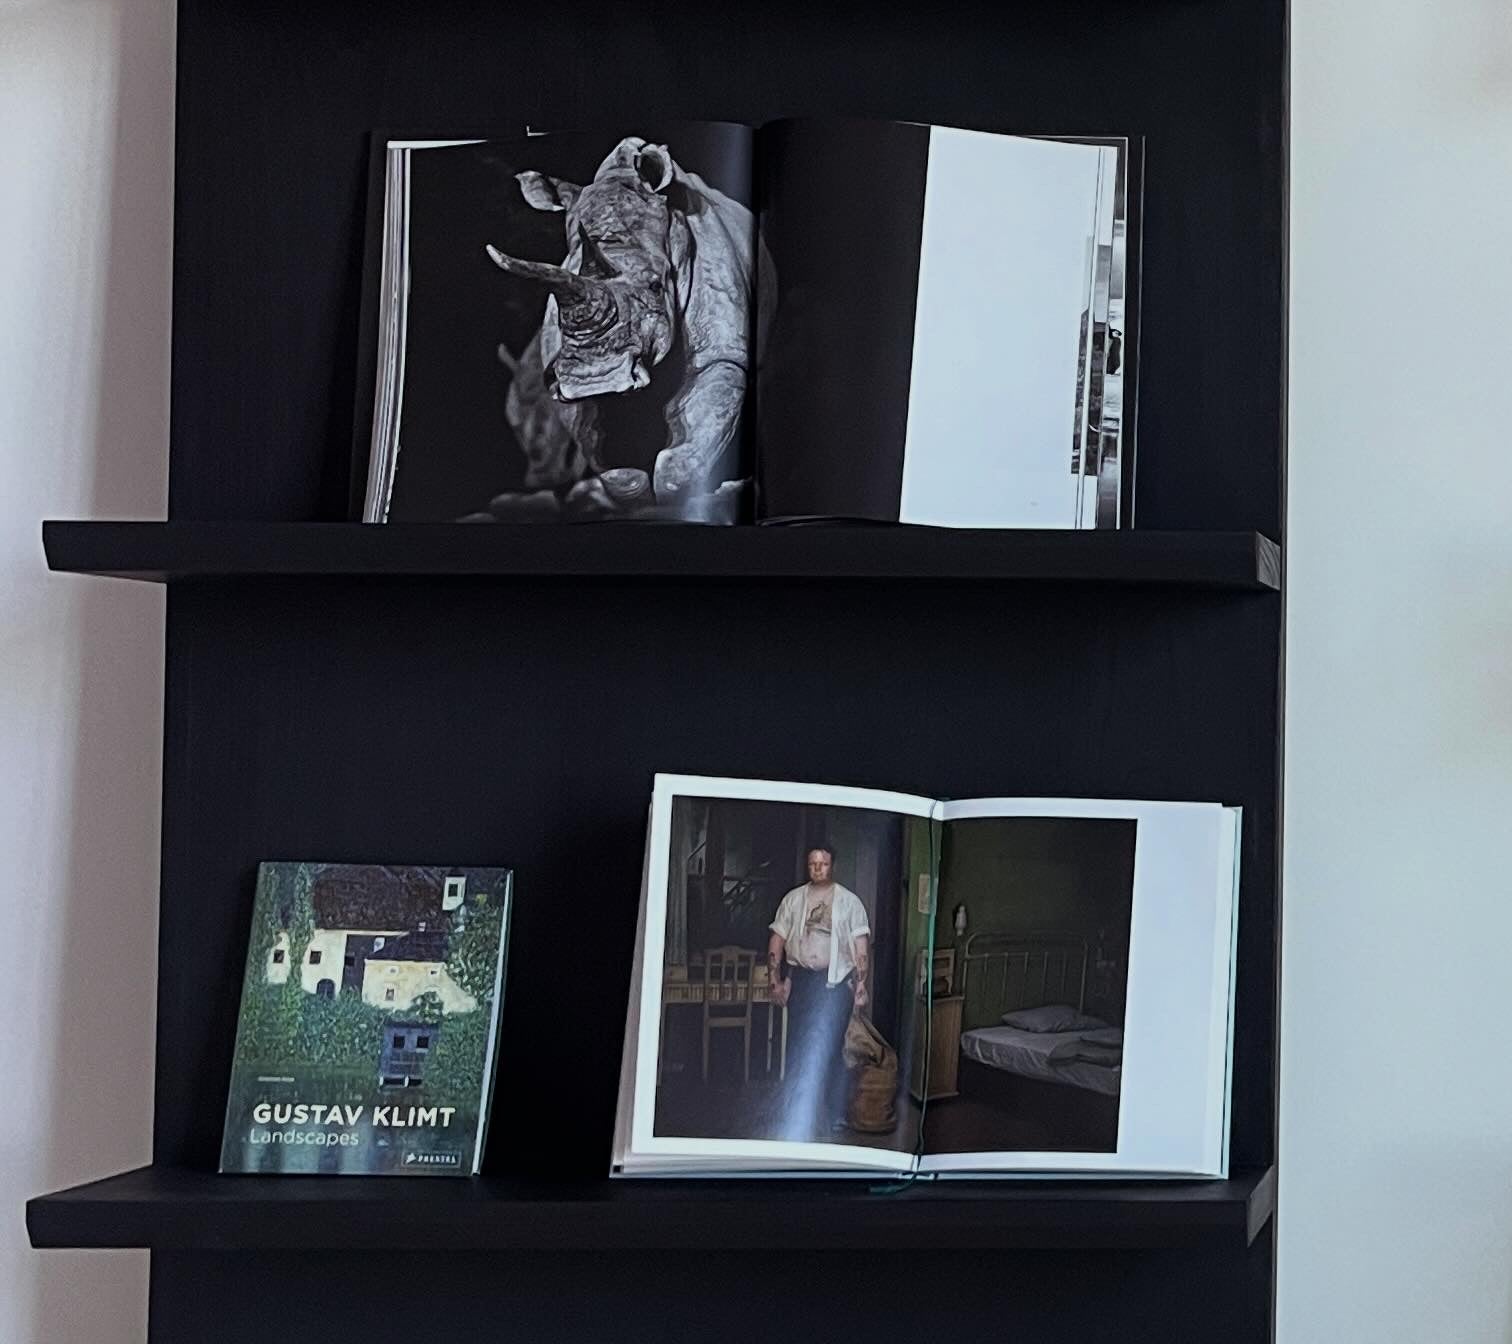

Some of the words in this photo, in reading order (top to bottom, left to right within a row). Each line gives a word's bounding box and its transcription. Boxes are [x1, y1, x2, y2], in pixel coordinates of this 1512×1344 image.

[253, 1103, 364, 1126] GUSTAV
[372, 1106, 456, 1128] KLIMT
[250, 1127, 360, 1148] Landscapes
